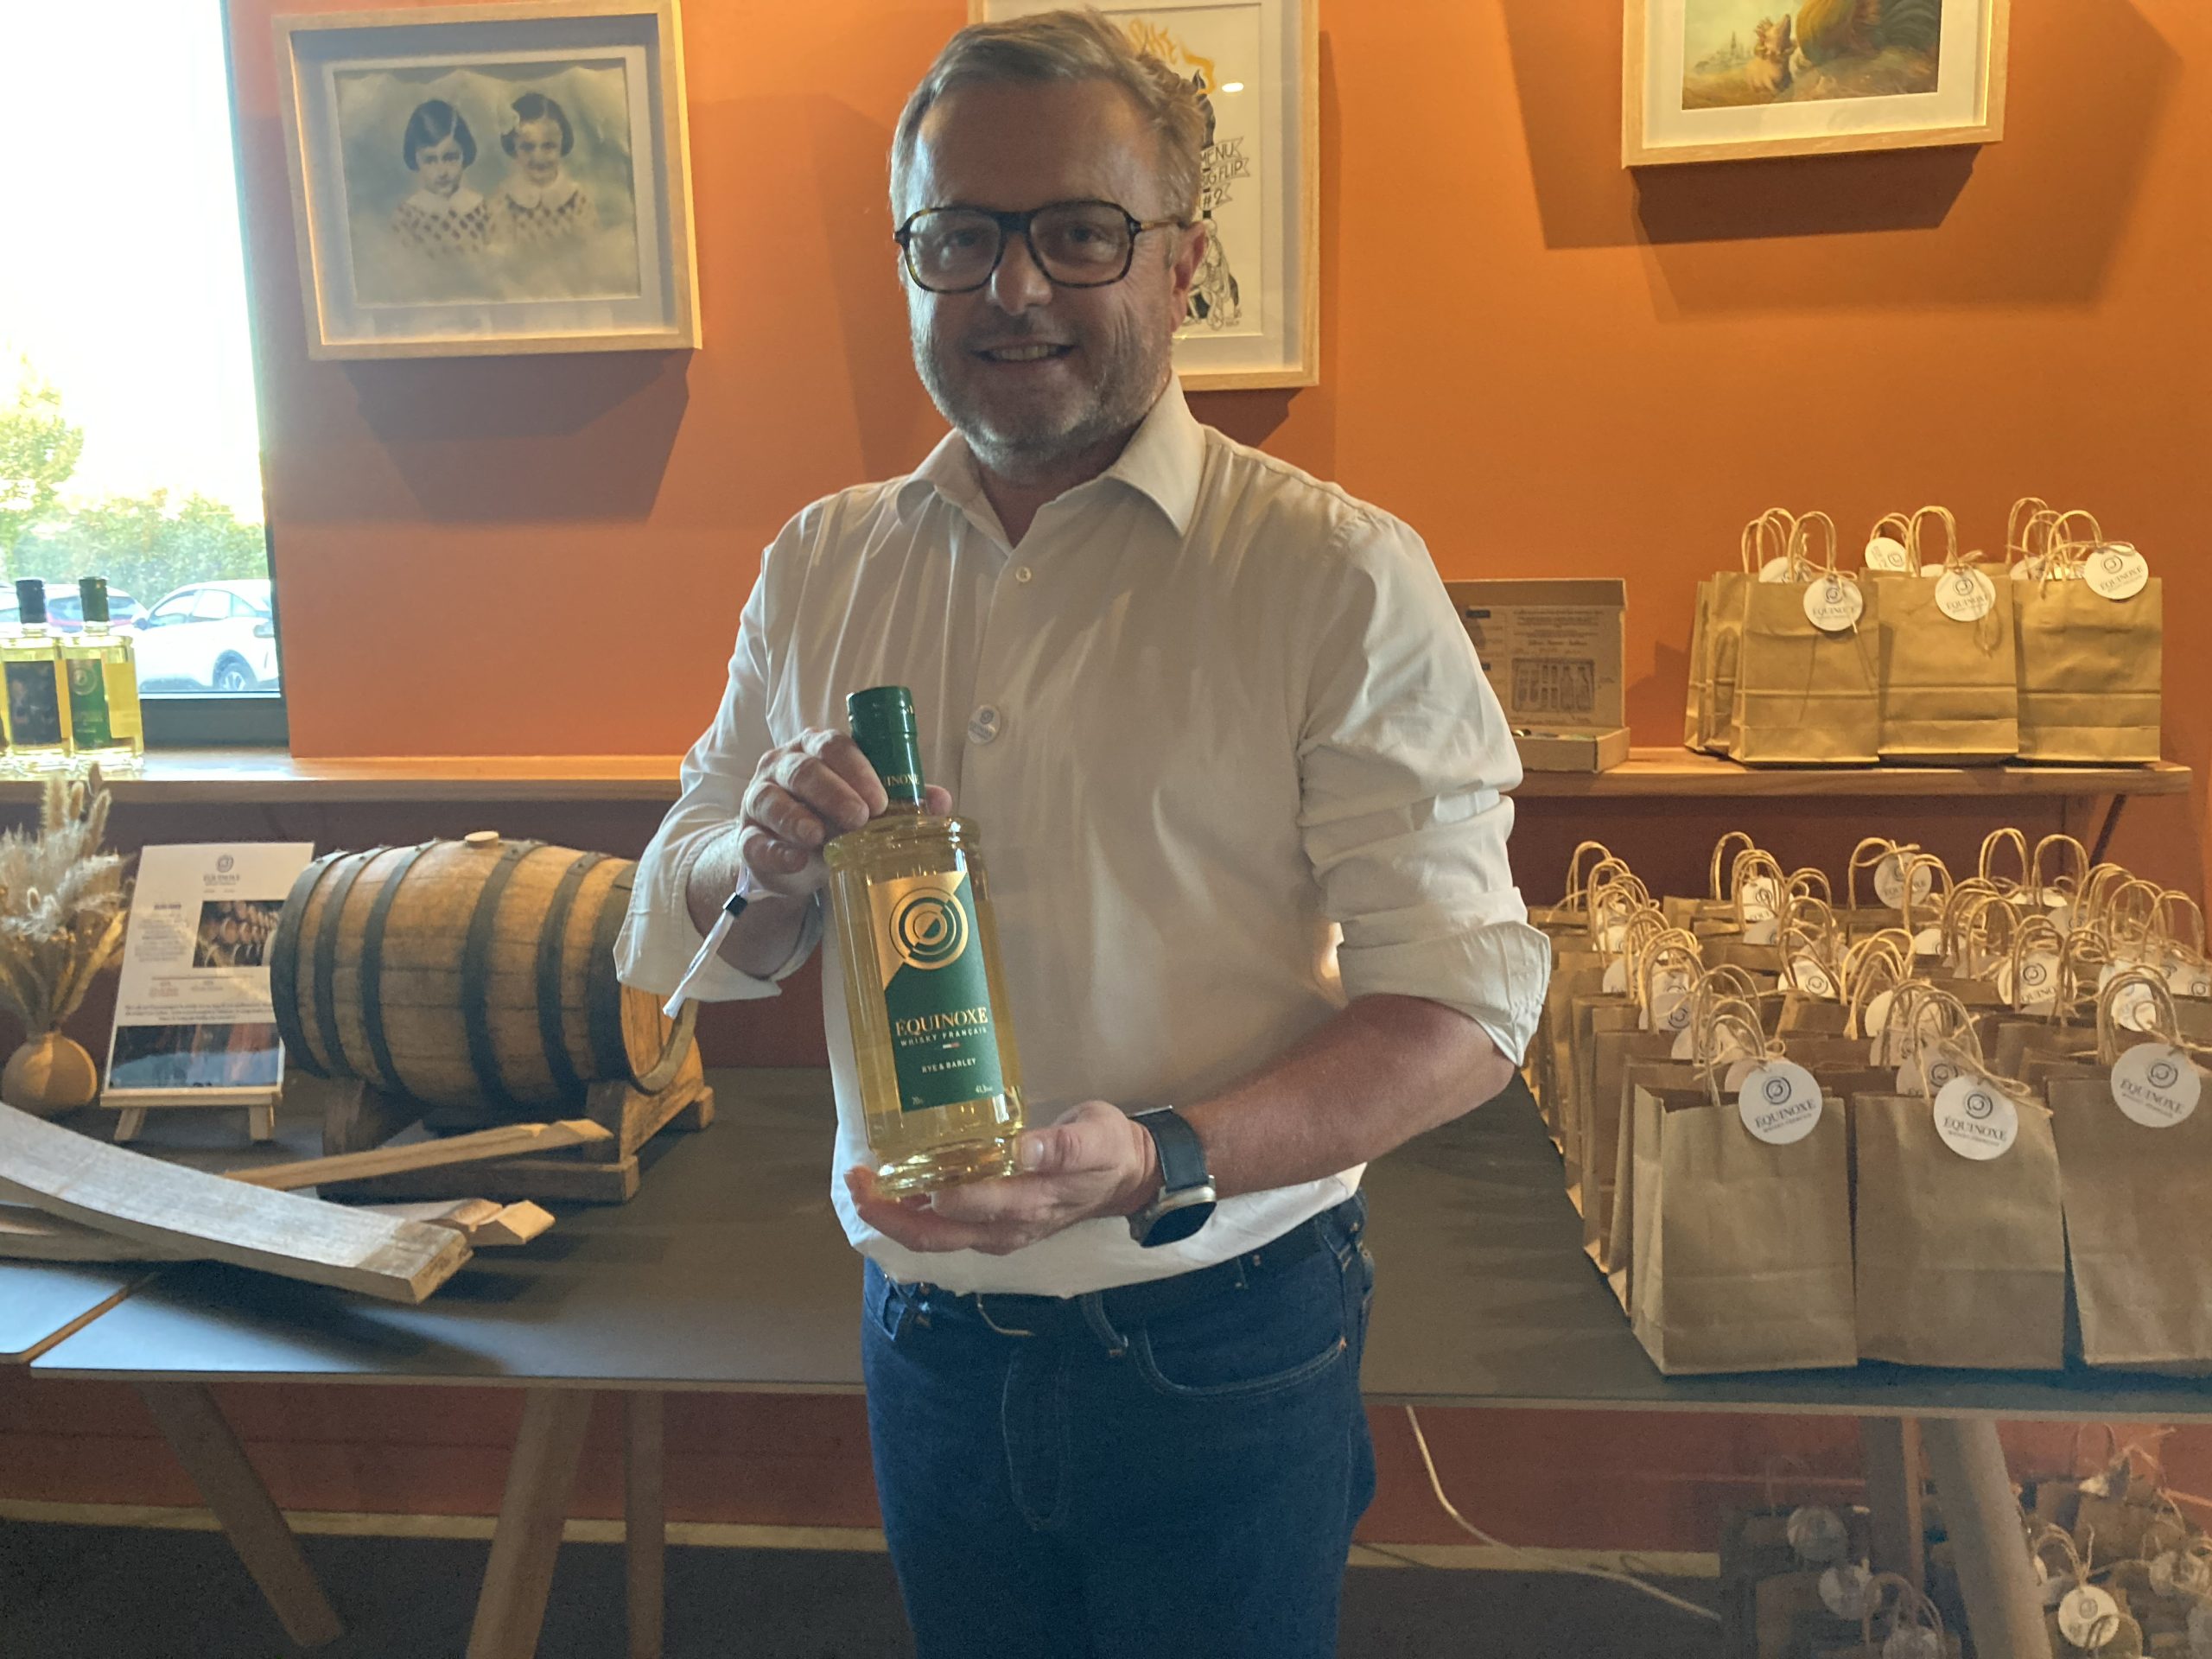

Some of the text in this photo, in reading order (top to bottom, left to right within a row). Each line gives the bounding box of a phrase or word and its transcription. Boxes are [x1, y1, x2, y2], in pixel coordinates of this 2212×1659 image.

[900, 1027, 987, 1046] WHISKY FRANÇAIS
[922, 1065, 938, 1073] RYE
[946, 1058, 976, 1069] BARLEY
